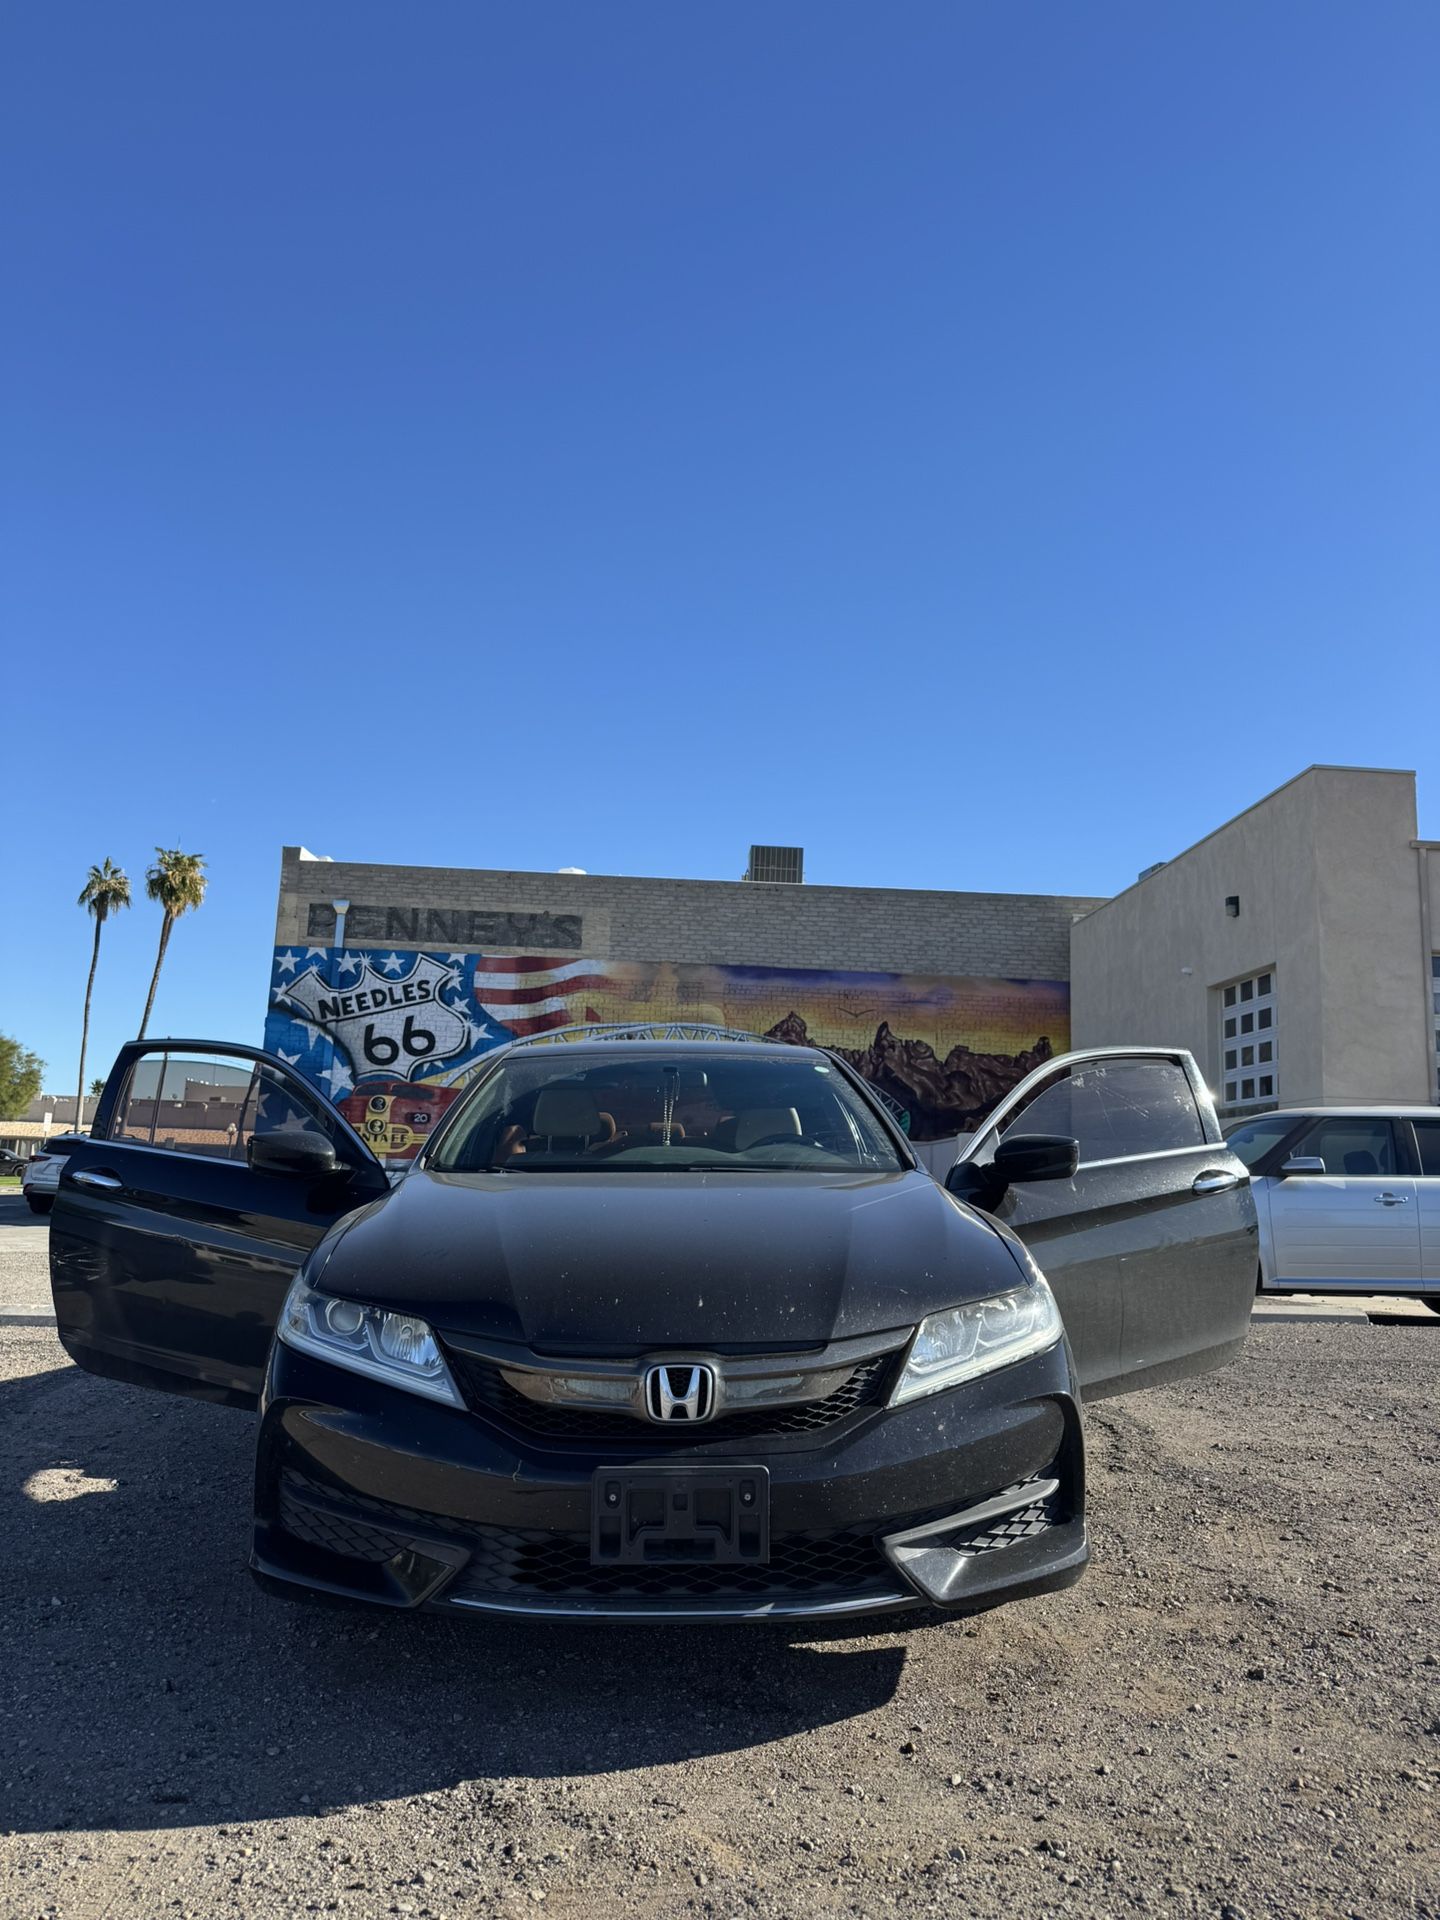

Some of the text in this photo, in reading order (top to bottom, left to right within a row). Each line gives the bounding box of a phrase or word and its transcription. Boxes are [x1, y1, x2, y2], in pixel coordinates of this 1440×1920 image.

[318, 980, 431, 1019] NEEDLES
[364, 1015, 436, 1066] 66
[413, 1113, 428, 1122] 20
